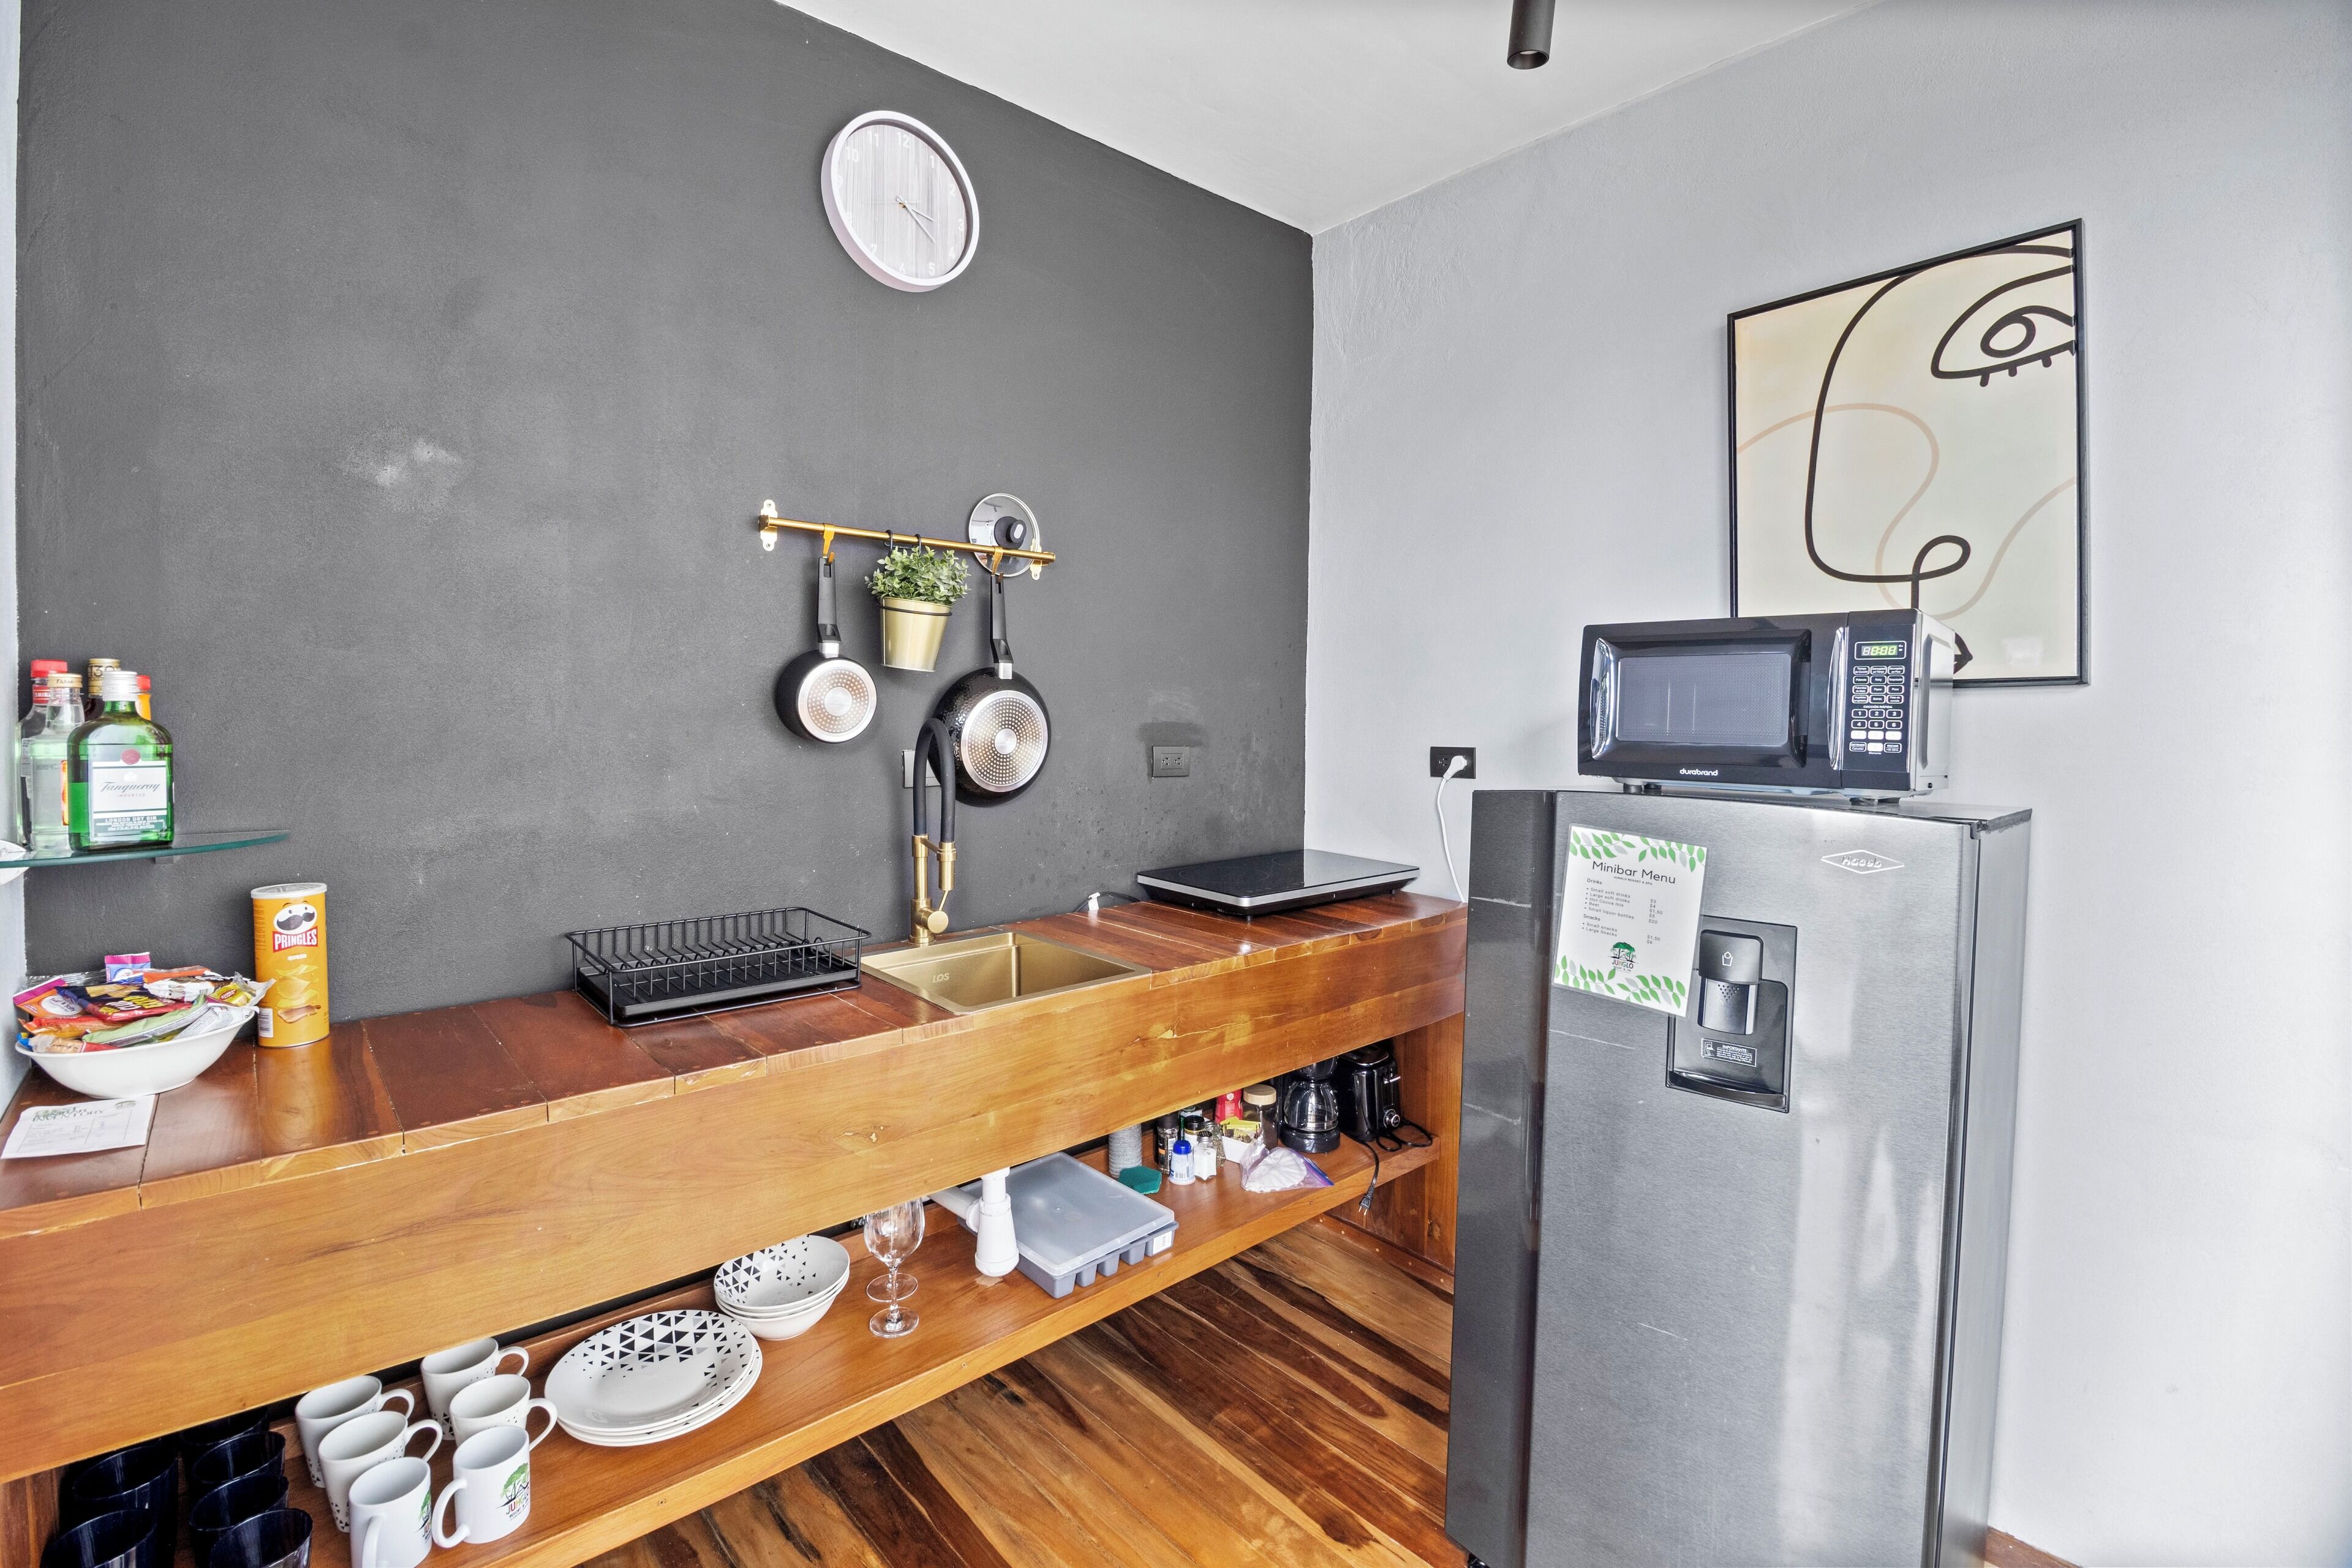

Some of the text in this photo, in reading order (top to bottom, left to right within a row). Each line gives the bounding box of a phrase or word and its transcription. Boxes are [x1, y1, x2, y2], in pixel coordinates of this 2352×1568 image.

[896, 132, 910, 149] 12
[930, 155, 935, 168] 1
[949, 184, 956, 197] 2
[929, 262, 936, 276] 5
[1679, 767, 1718, 776] durabrand
[100, 781, 160, 793] Tanqueray
[1593, 861, 1675, 884] Minibar Menu
[275, 928, 317, 950] PRINGLES
[1611, 959, 1634, 969] JUNGLO
[1722, 1044, 1747, 1053] IMPORTANTE
